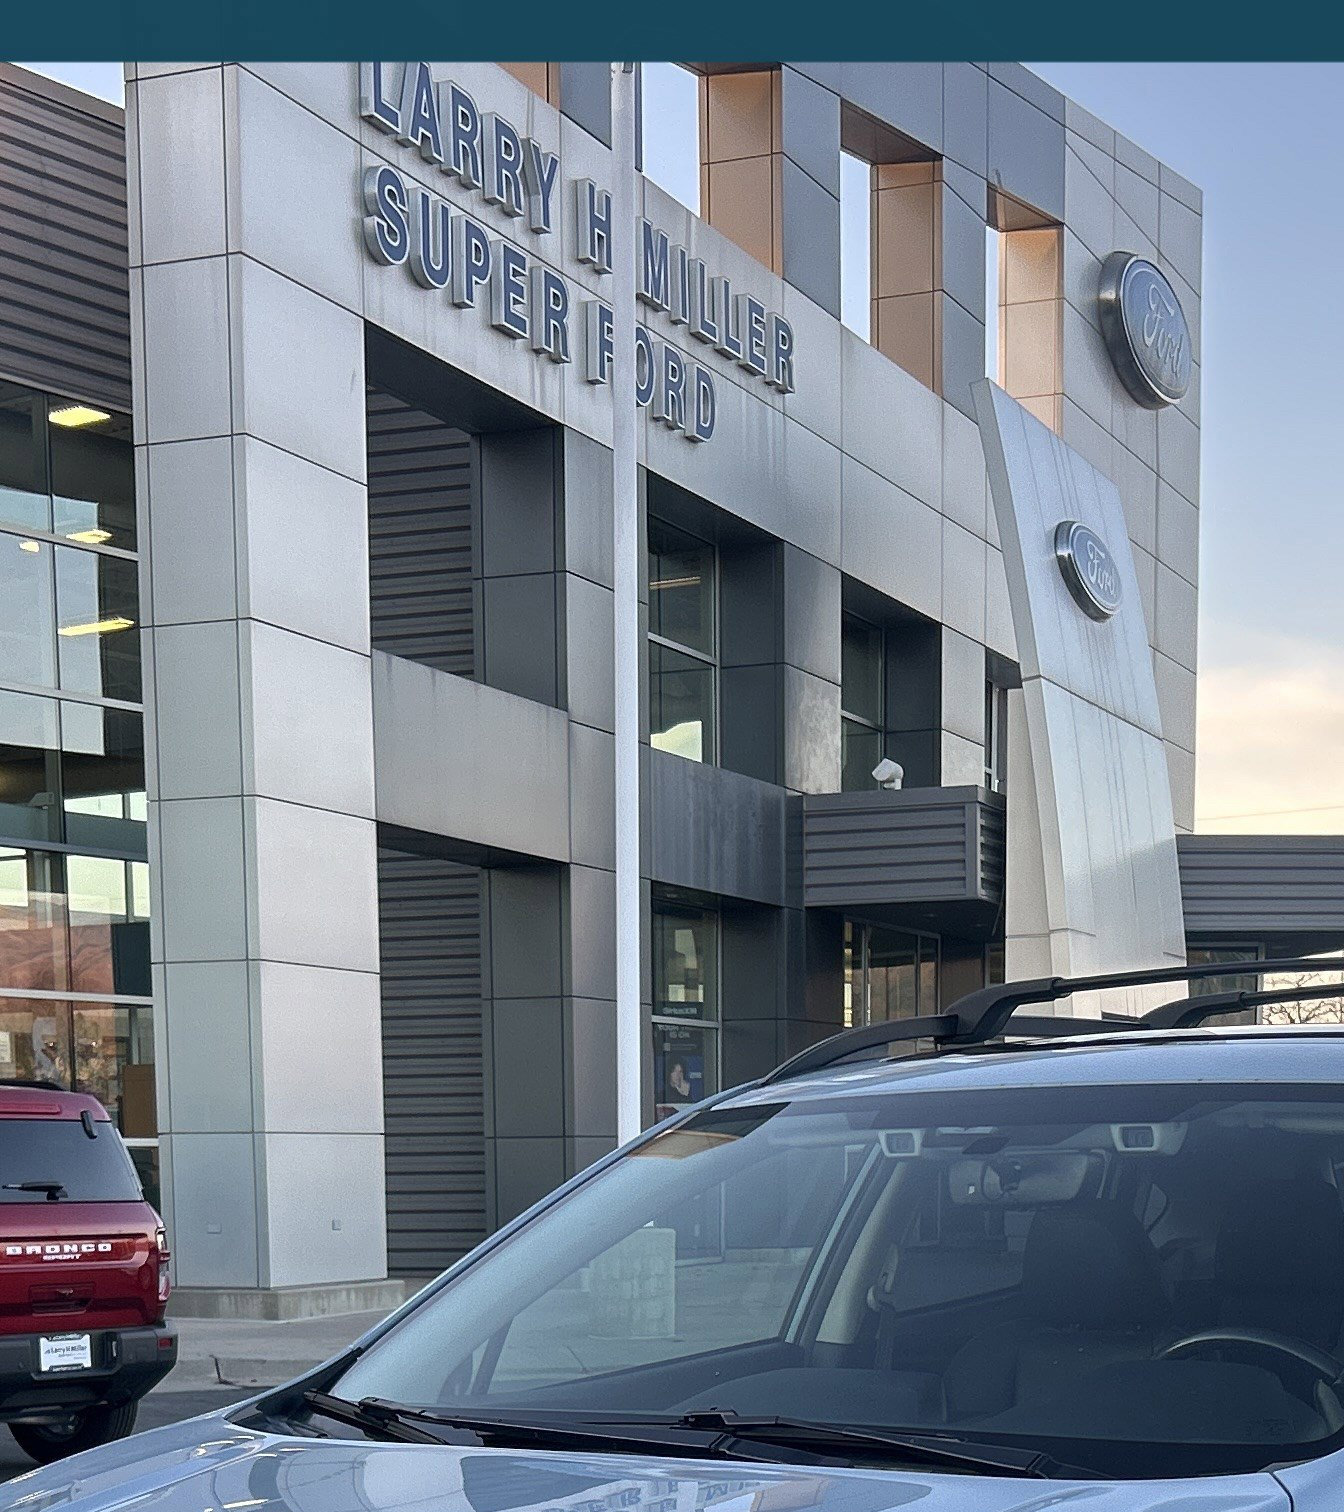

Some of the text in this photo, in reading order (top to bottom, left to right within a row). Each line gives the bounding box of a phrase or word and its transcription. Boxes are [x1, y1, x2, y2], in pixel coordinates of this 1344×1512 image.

[360, 62, 795, 394] LARRY H MILLER
[362, 165, 716, 444] SUPER FORD
[1142, 283, 1184, 378] Ford
[1086, 538, 1117, 598] Ford
